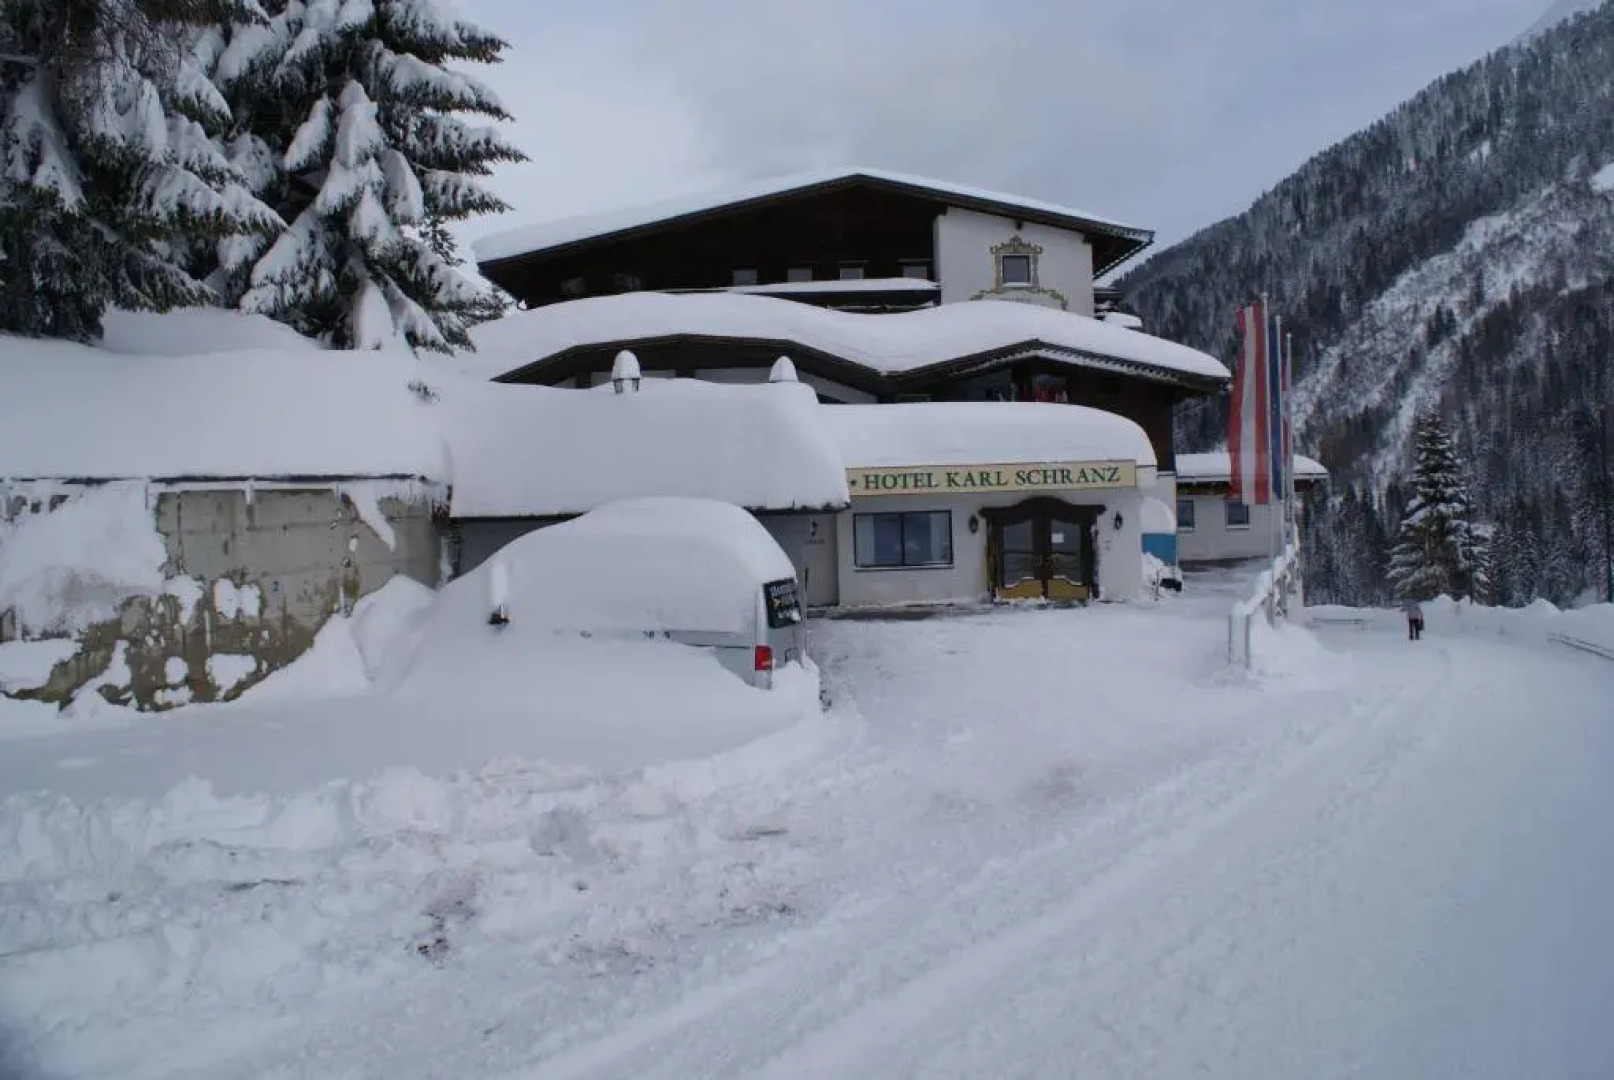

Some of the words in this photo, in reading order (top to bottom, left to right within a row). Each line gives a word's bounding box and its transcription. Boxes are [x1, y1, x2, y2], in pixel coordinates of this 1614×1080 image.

[864, 472, 939, 490] HOTEL
[946, 470, 1008, 487] KARL
[1015, 466, 1120, 486] SCHRANZ
